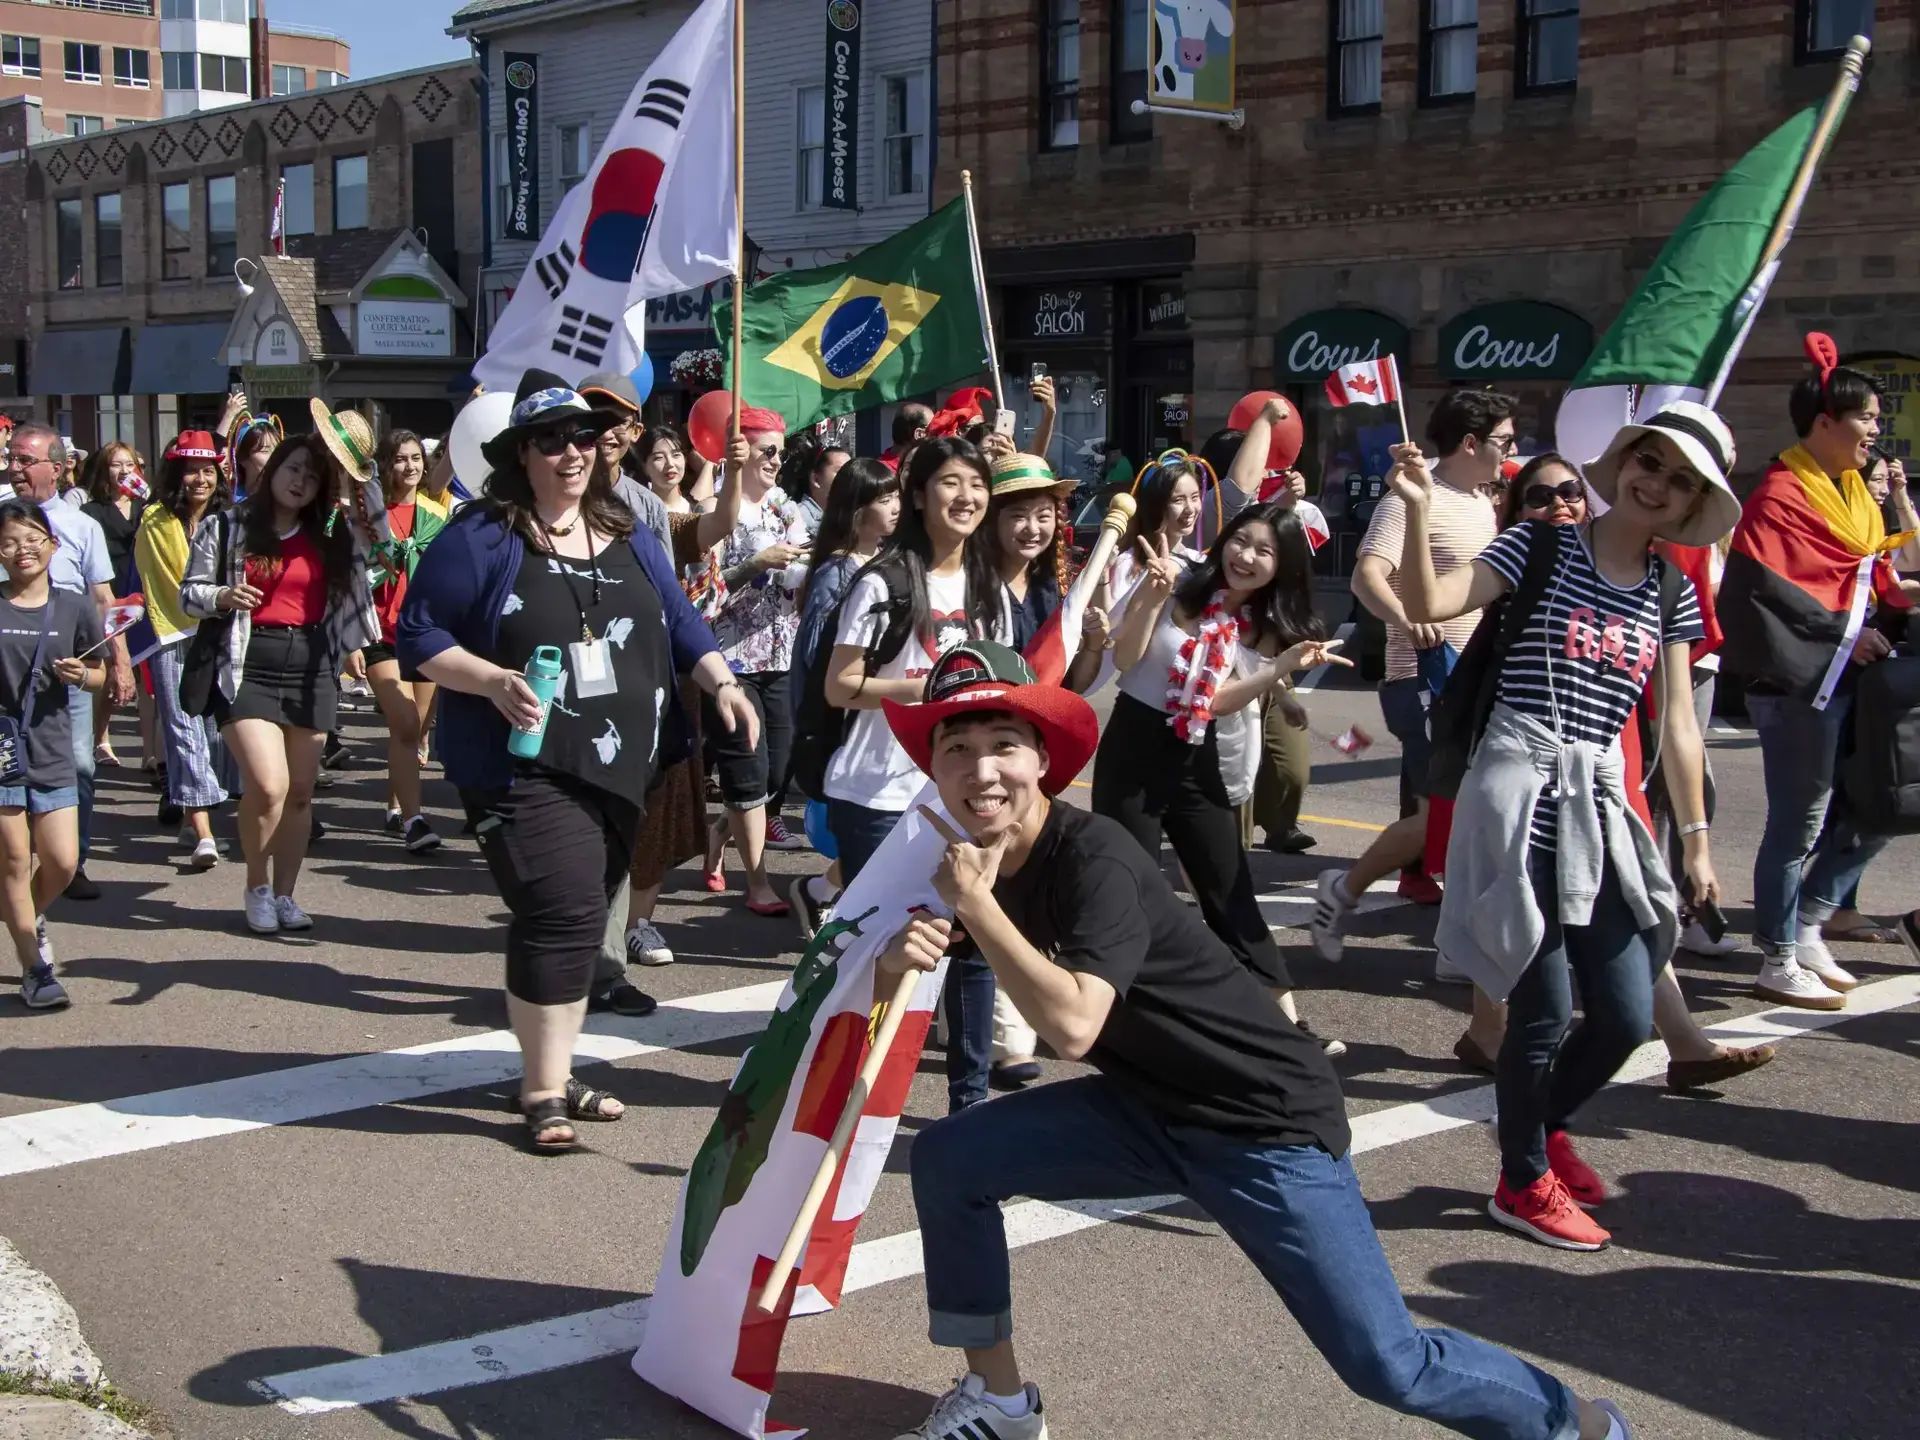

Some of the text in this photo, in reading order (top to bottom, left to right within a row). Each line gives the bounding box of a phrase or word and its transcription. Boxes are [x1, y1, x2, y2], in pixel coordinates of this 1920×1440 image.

[1038, 293, 1058, 312] 150
[1149, 299, 1185, 323] WATERH
[363, 314, 431, 324] CONFEDERATION
[1034, 310, 1084, 336] SALON
[371, 323, 423, 333] COURT MALL
[374, 339, 436, 349] MALL ENTRANCE
[1454, 325, 1560, 370] Cows
[1164, 410, 1189, 422] SALON
